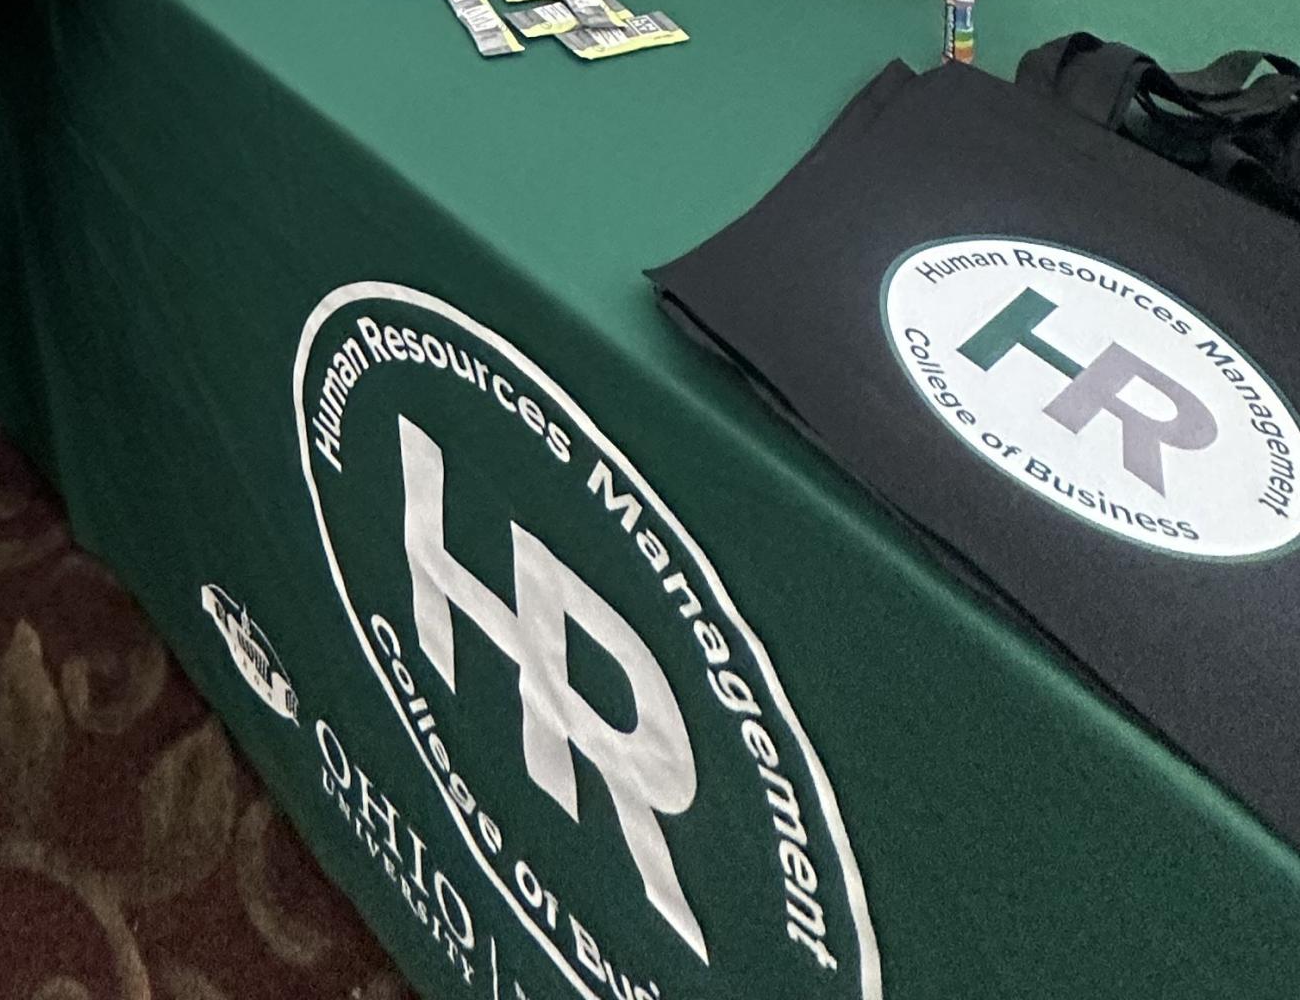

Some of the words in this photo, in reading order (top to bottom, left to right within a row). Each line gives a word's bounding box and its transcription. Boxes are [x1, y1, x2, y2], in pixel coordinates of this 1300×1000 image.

[905, 327, 978, 426] College
[981, 431, 1022, 459] of
[1024, 456, 1200, 541] Business
[915, 248, 1009, 284] Human
[1013, 248, 1192, 336] Resources
[1196, 340, 1295, 519] Management
[956, 286, 1218, 498] HR
[315, 336, 370, 473] Human
[357, 316, 572, 464] Resources
[586, 459, 838, 972] Management
[370, 613, 502, 855] College
[398, 412, 709, 967] HR
[316, 719, 475, 949] OHIO
[321, 765, 475, 986] UNIVERSITY
